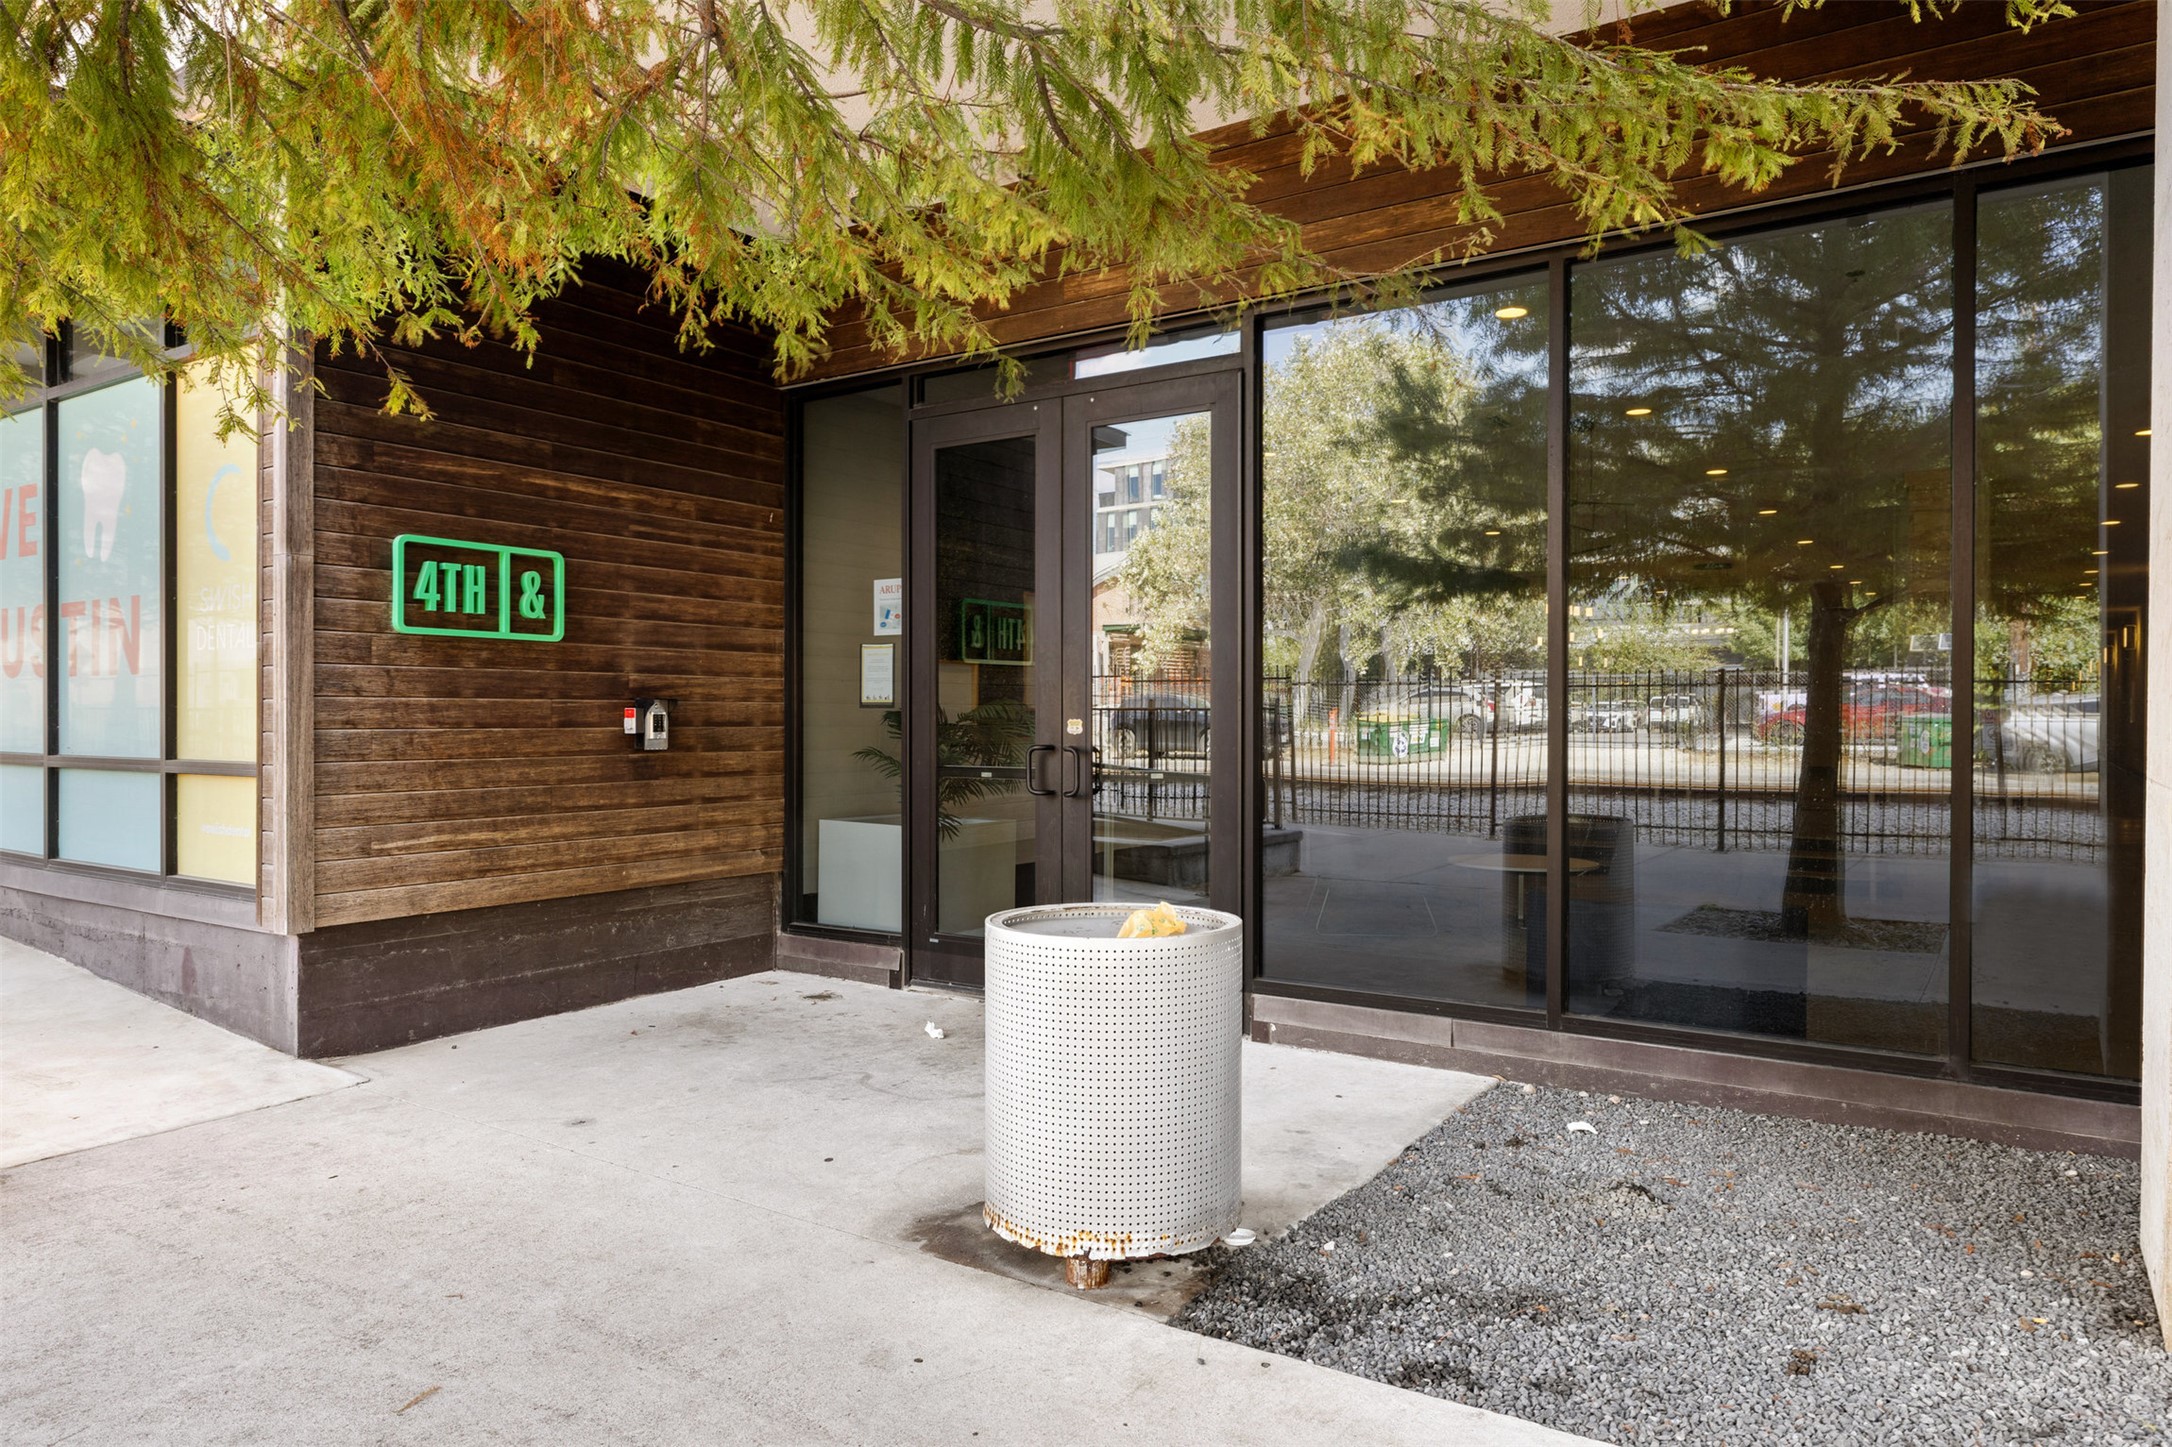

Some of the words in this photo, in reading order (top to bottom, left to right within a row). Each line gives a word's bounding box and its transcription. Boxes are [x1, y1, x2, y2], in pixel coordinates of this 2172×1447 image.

[200, 579, 253, 611] SWISH
[413, 560, 486, 614] 4TH
[519, 571, 546, 619] &
[196, 622, 256, 651] DENTAL
